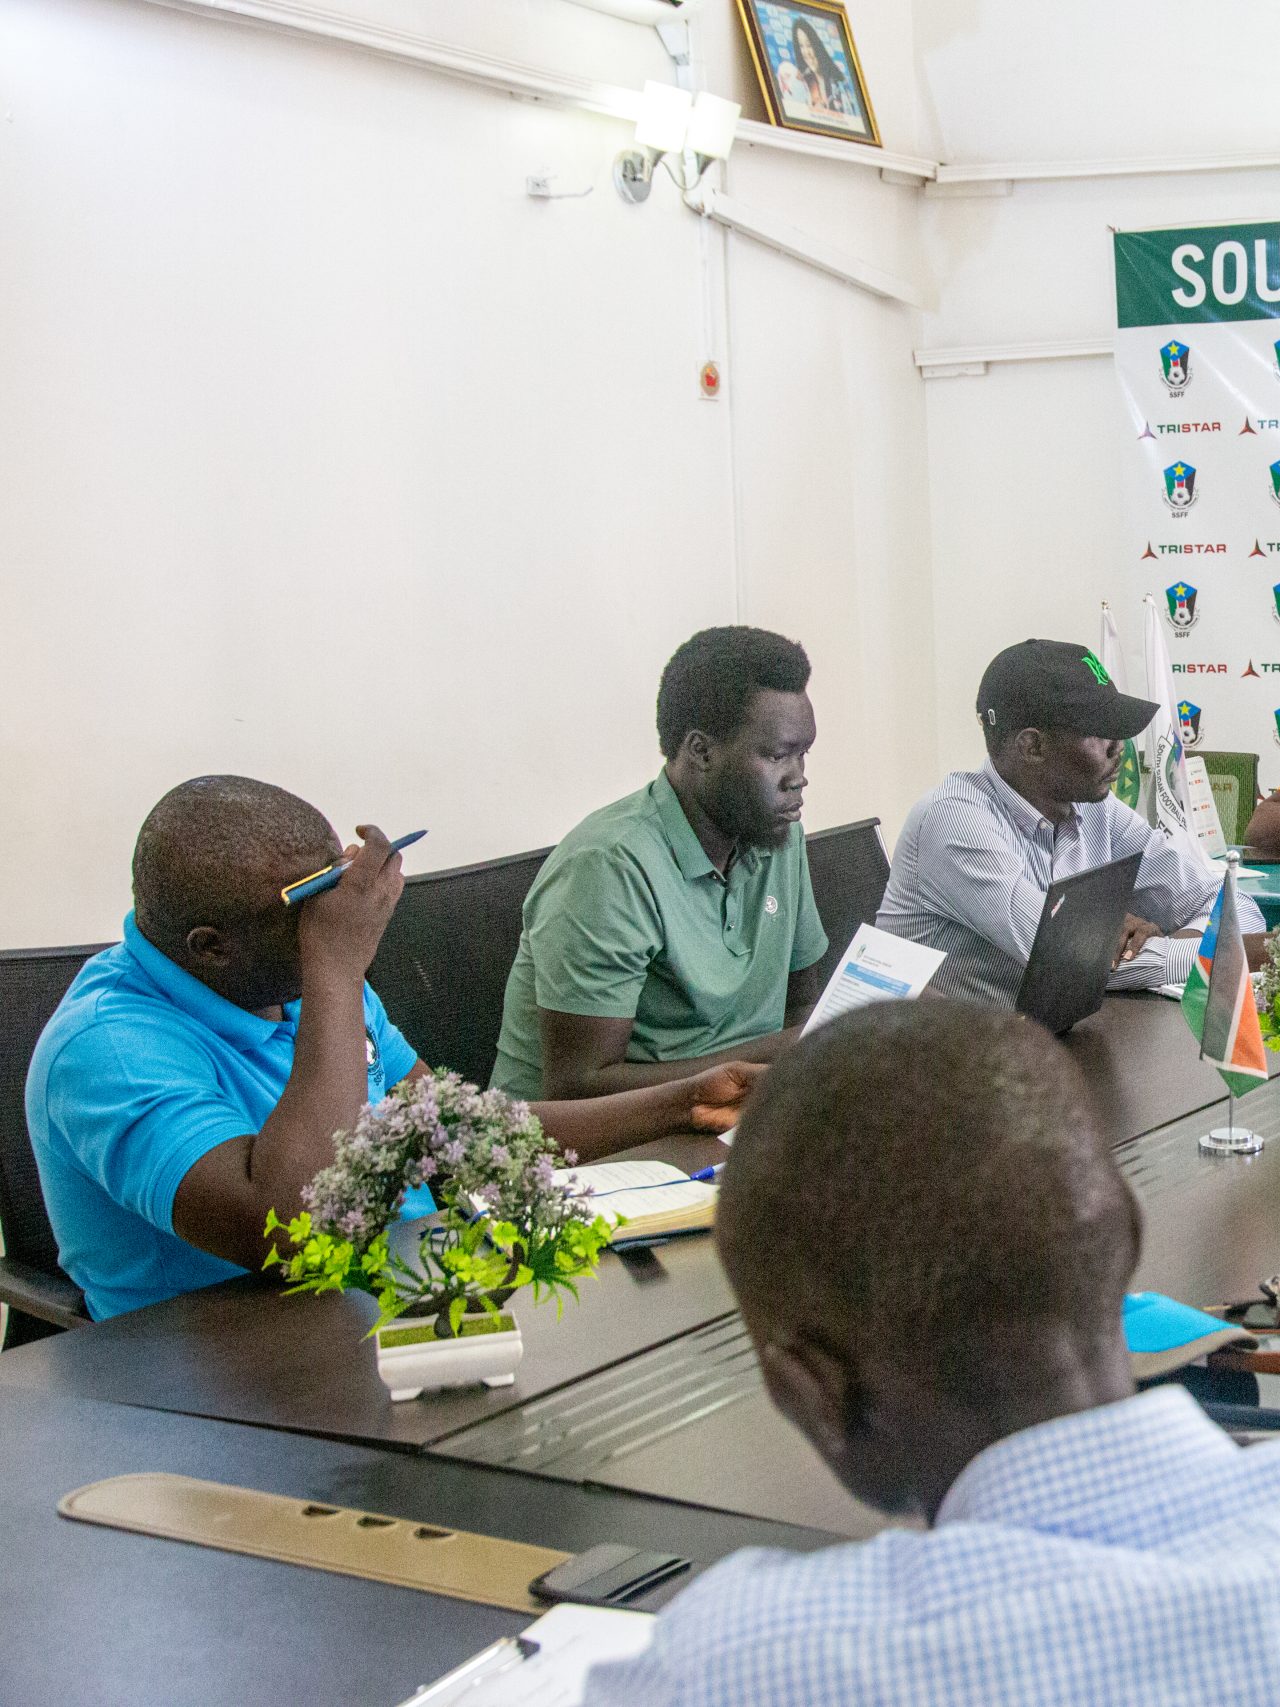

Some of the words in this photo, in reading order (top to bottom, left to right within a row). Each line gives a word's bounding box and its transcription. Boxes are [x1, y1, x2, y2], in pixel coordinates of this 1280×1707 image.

[1169, 390, 1185, 399] SSFF
[1156, 421, 1222, 434] TRISTAR
[1171, 511, 1189, 519] SSFF
[1158, 543, 1227, 555] TRISTAR
[1174, 631, 1191, 639] SSFF
[1171, 663, 1228, 674] RISTAR
